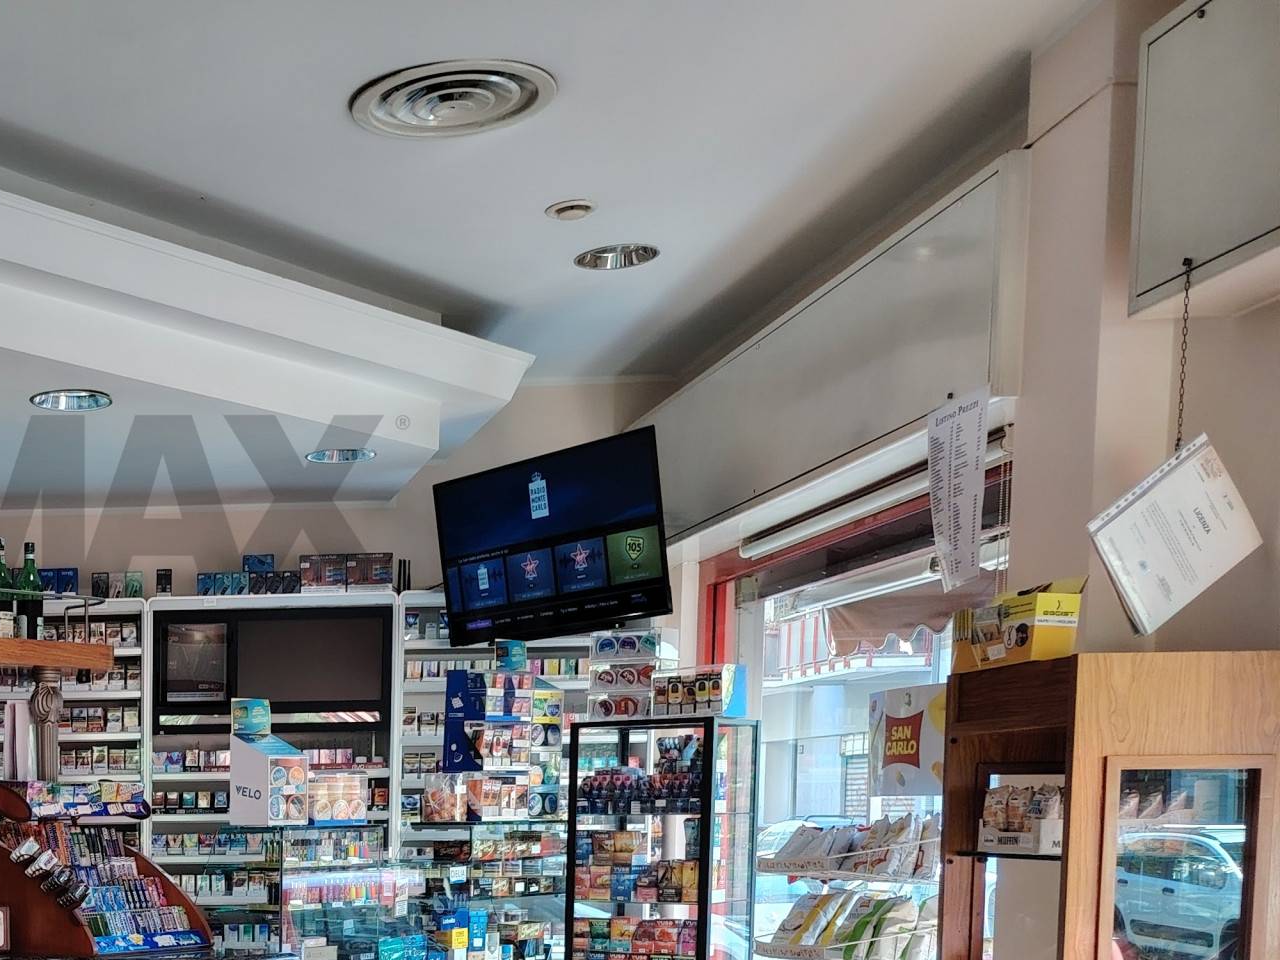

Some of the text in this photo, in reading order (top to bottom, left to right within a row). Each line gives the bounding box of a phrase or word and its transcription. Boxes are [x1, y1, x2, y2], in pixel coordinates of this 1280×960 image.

[1193, 507, 1212, 535] LICENZA
[627, 542, 642, 553] 105
[890, 725, 912, 740] SAN
[885, 740, 917, 756] CARLO
[235, 785, 262, 801] VELO
[998, 836, 1018, 846] MUFFIN
